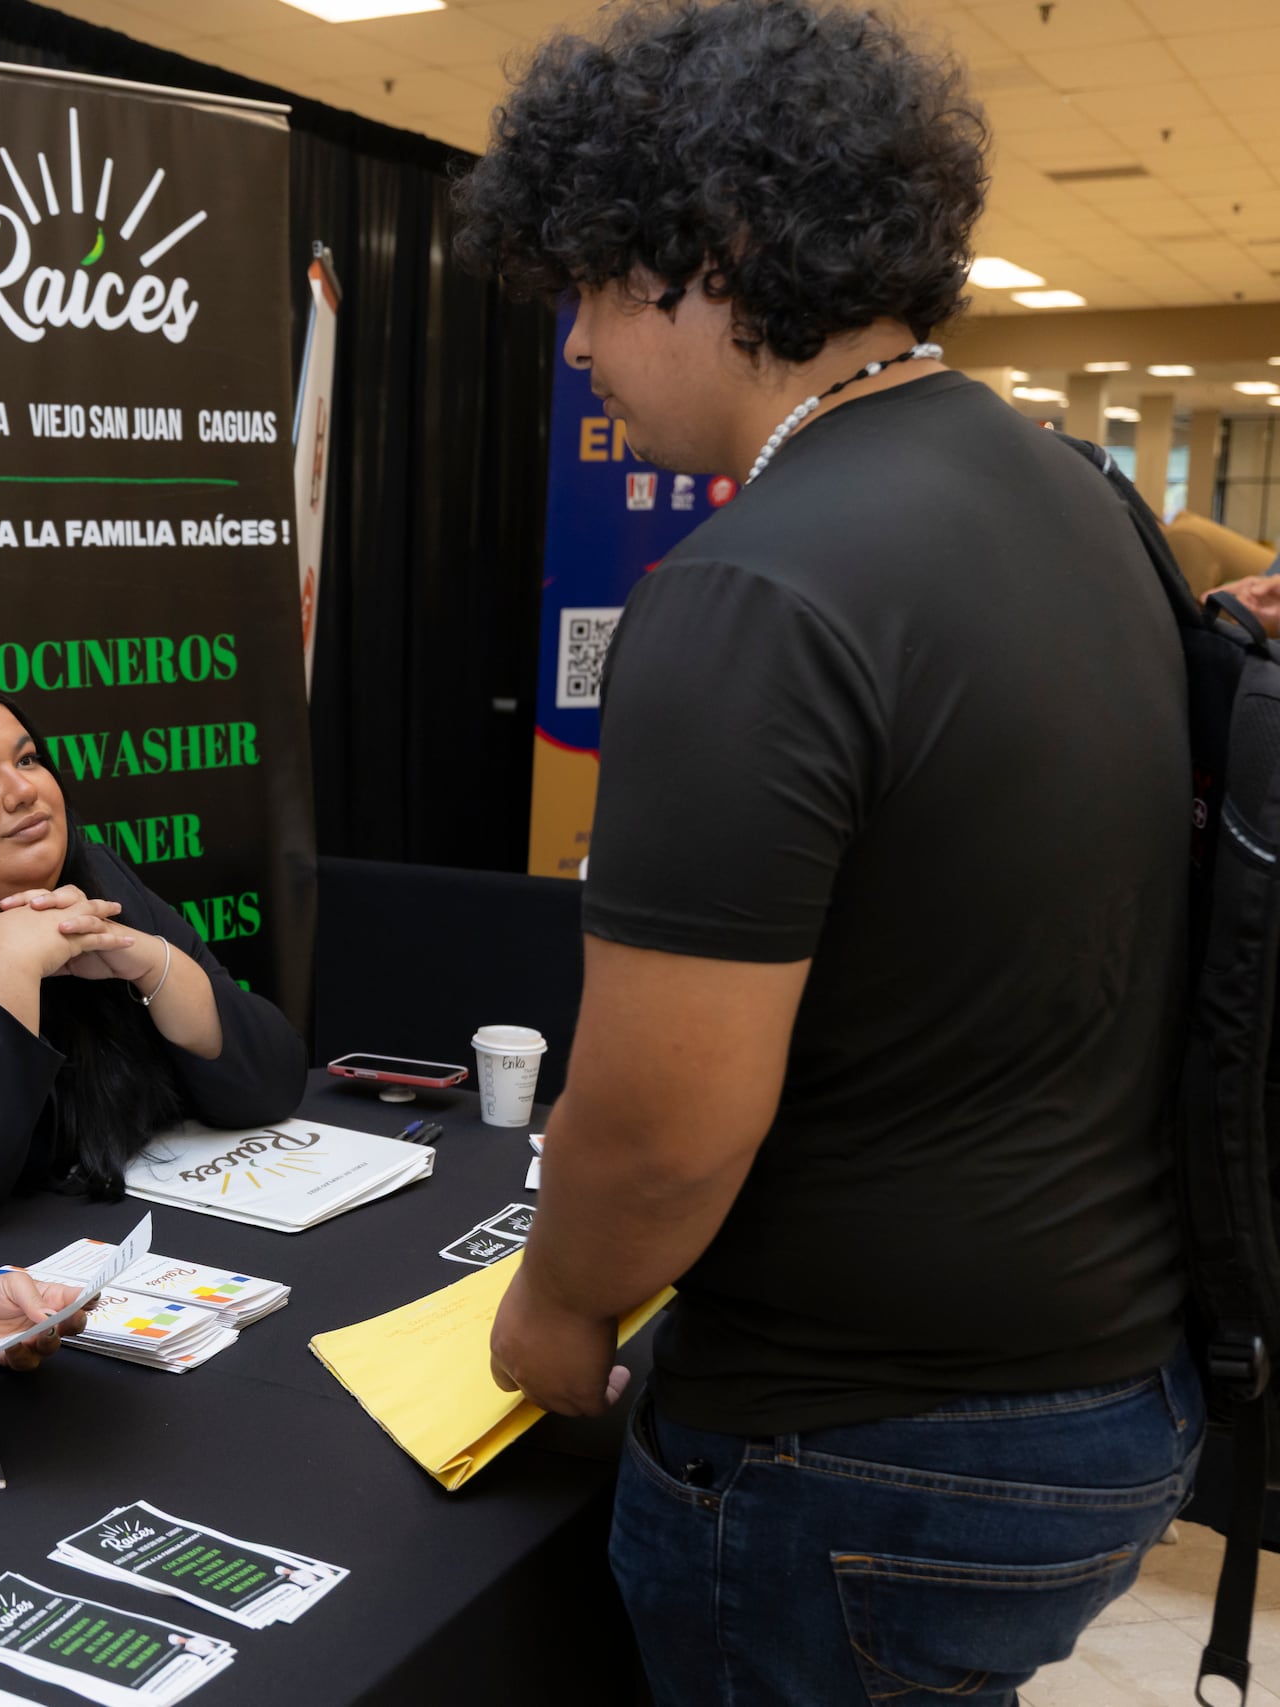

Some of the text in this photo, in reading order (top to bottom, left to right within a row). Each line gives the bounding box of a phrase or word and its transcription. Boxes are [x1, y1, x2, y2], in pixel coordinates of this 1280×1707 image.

[29, 403, 85, 438] VIEJO
[89, 405, 128, 440] SAN
[131, 407, 183, 441] JUAN
[198, 410, 277, 443] CAGUAS
[24, 520, 61, 547] LA
[66, 520, 177, 547] FAMILIA
